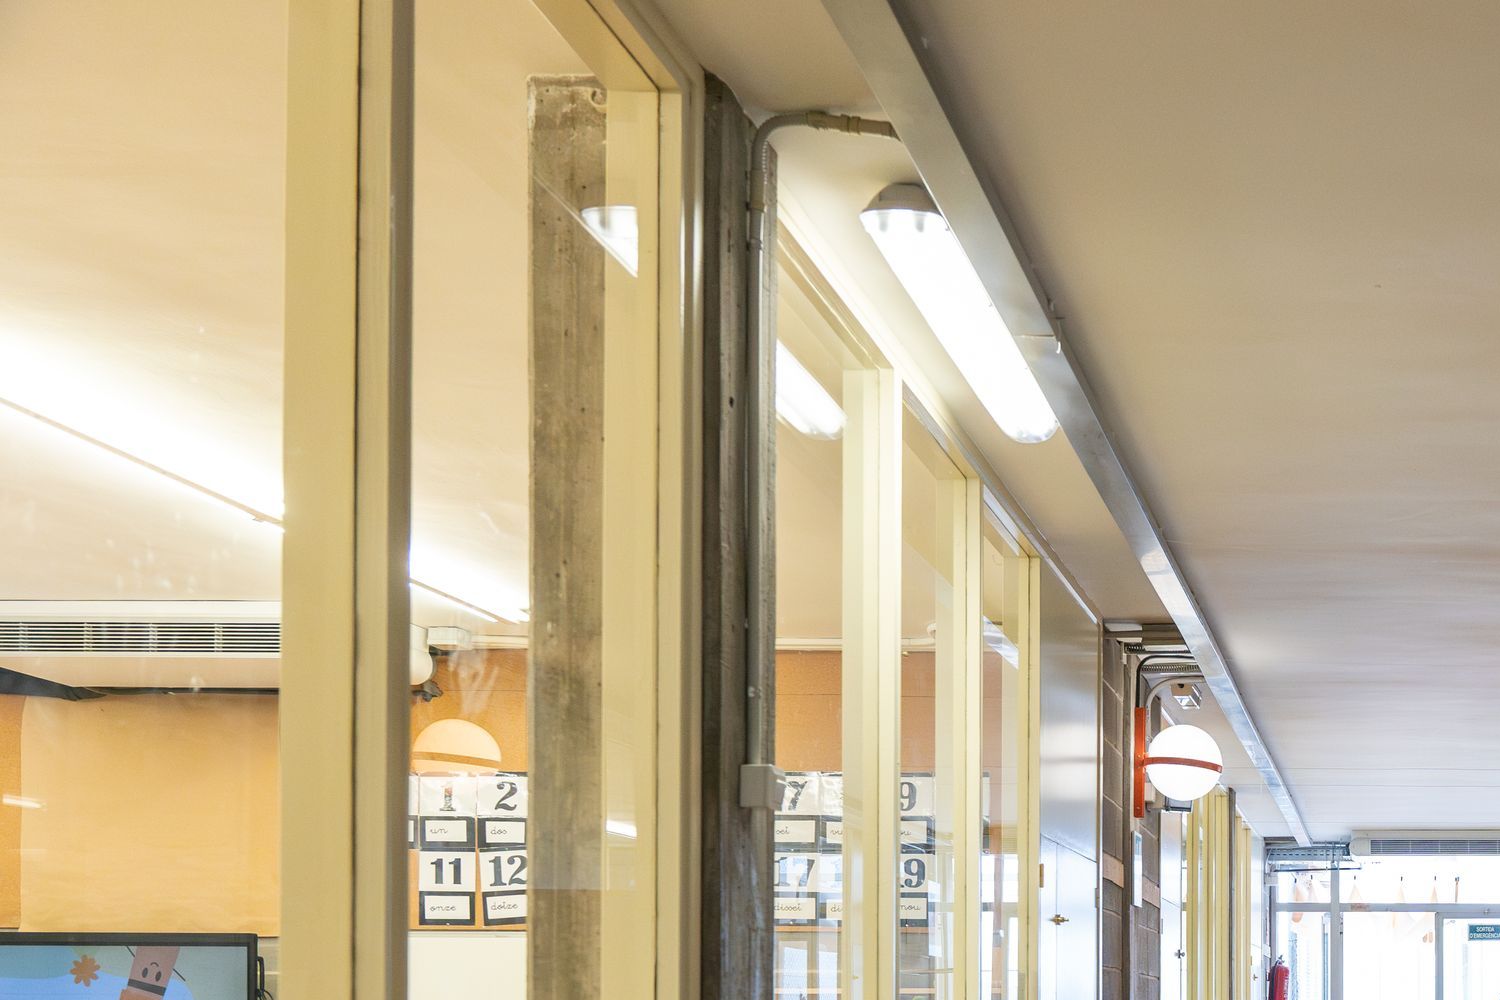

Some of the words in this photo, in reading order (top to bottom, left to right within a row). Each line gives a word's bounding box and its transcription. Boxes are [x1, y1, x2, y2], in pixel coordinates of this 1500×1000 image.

[494, 781, 518, 811] 2
[899, 781, 917, 811] 9
[490, 826, 508, 835] dos
[430, 857, 461, 885] 11
[489, 855, 527, 887] 12
[900, 858, 926, 888] 9
[429, 904, 457, 912] onze
[491, 901, 519, 911] dotze
